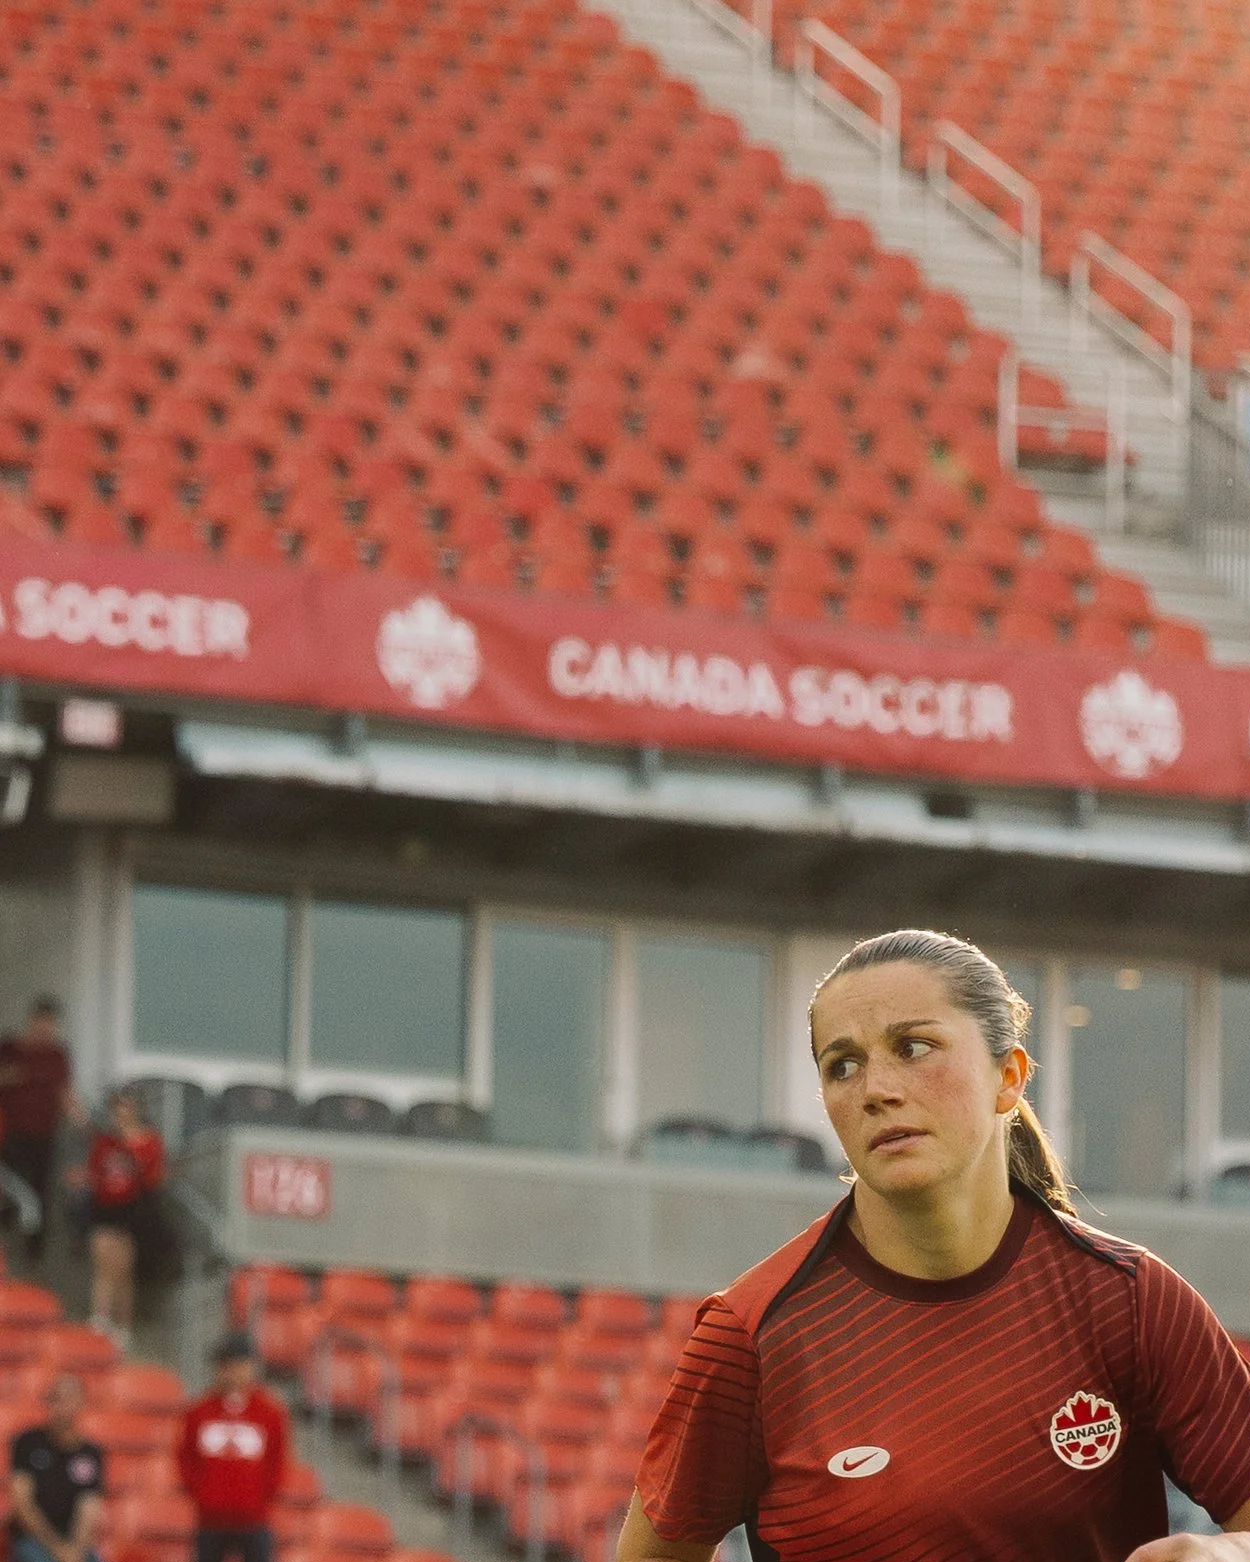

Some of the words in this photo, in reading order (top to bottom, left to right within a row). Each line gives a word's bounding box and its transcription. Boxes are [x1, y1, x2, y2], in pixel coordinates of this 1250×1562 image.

[12, 575, 249, 661] SOCCER
[548, 637, 783, 719] CANADA
[788, 664, 1015, 742] SOCCER
[1055, 1420, 1117, 1444] CANADA
